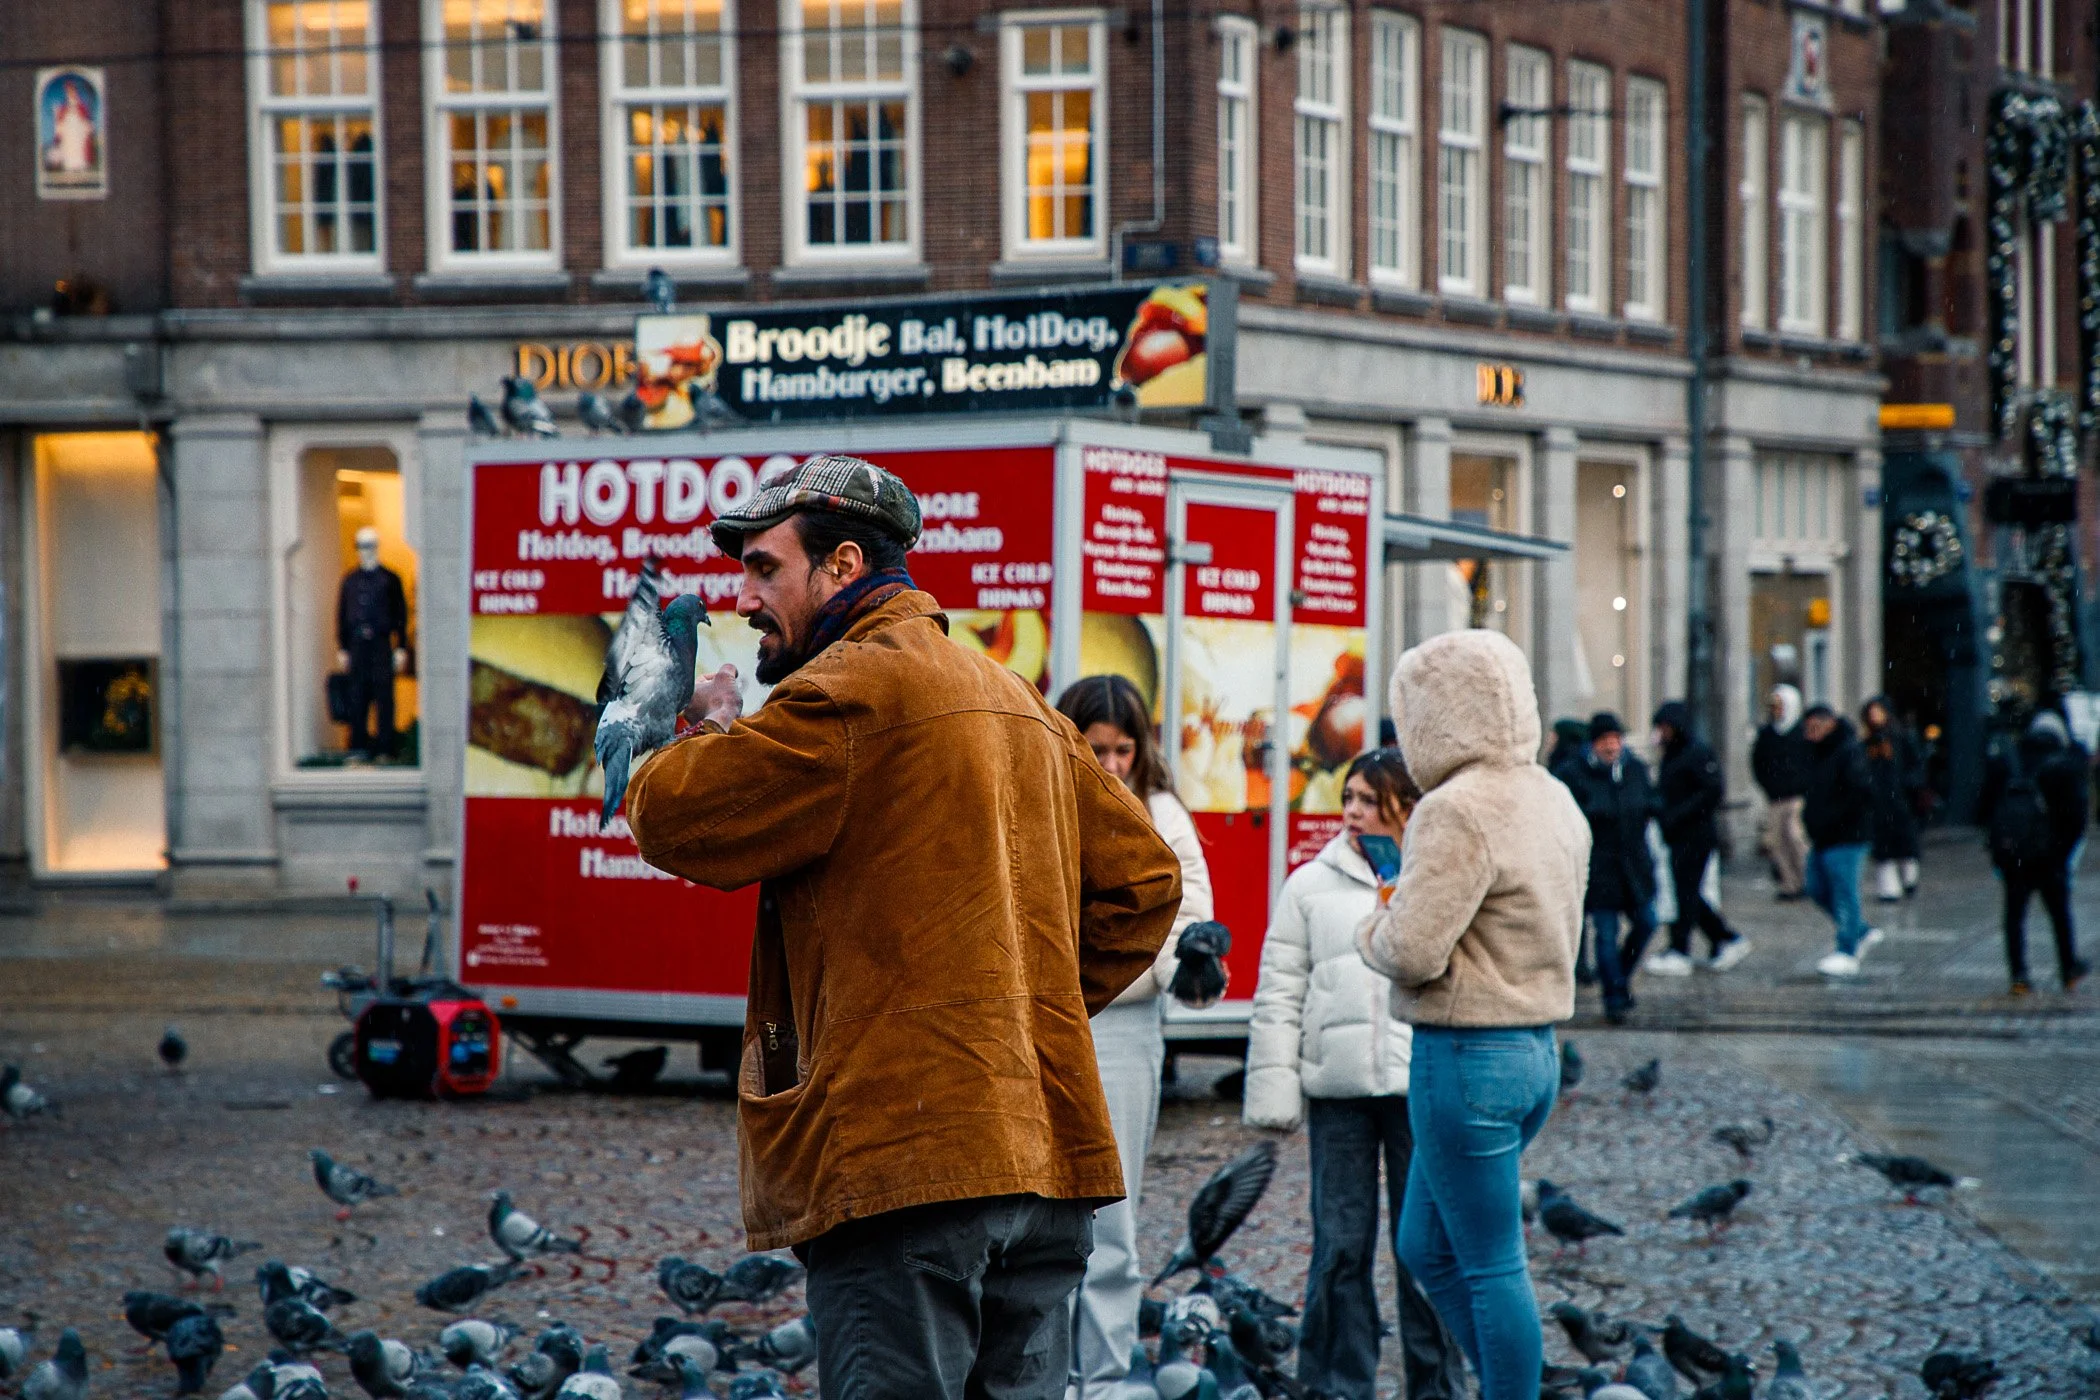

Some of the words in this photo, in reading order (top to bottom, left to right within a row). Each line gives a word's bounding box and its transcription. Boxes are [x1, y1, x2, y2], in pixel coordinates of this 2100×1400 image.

[726, 315, 890, 366] Broodje
[900, 318, 967, 355] Bal,
[741, 367, 935, 403] Hamburger,
[942, 355, 1101, 394] Beenham
[541, 456, 810, 526] HOTDO
